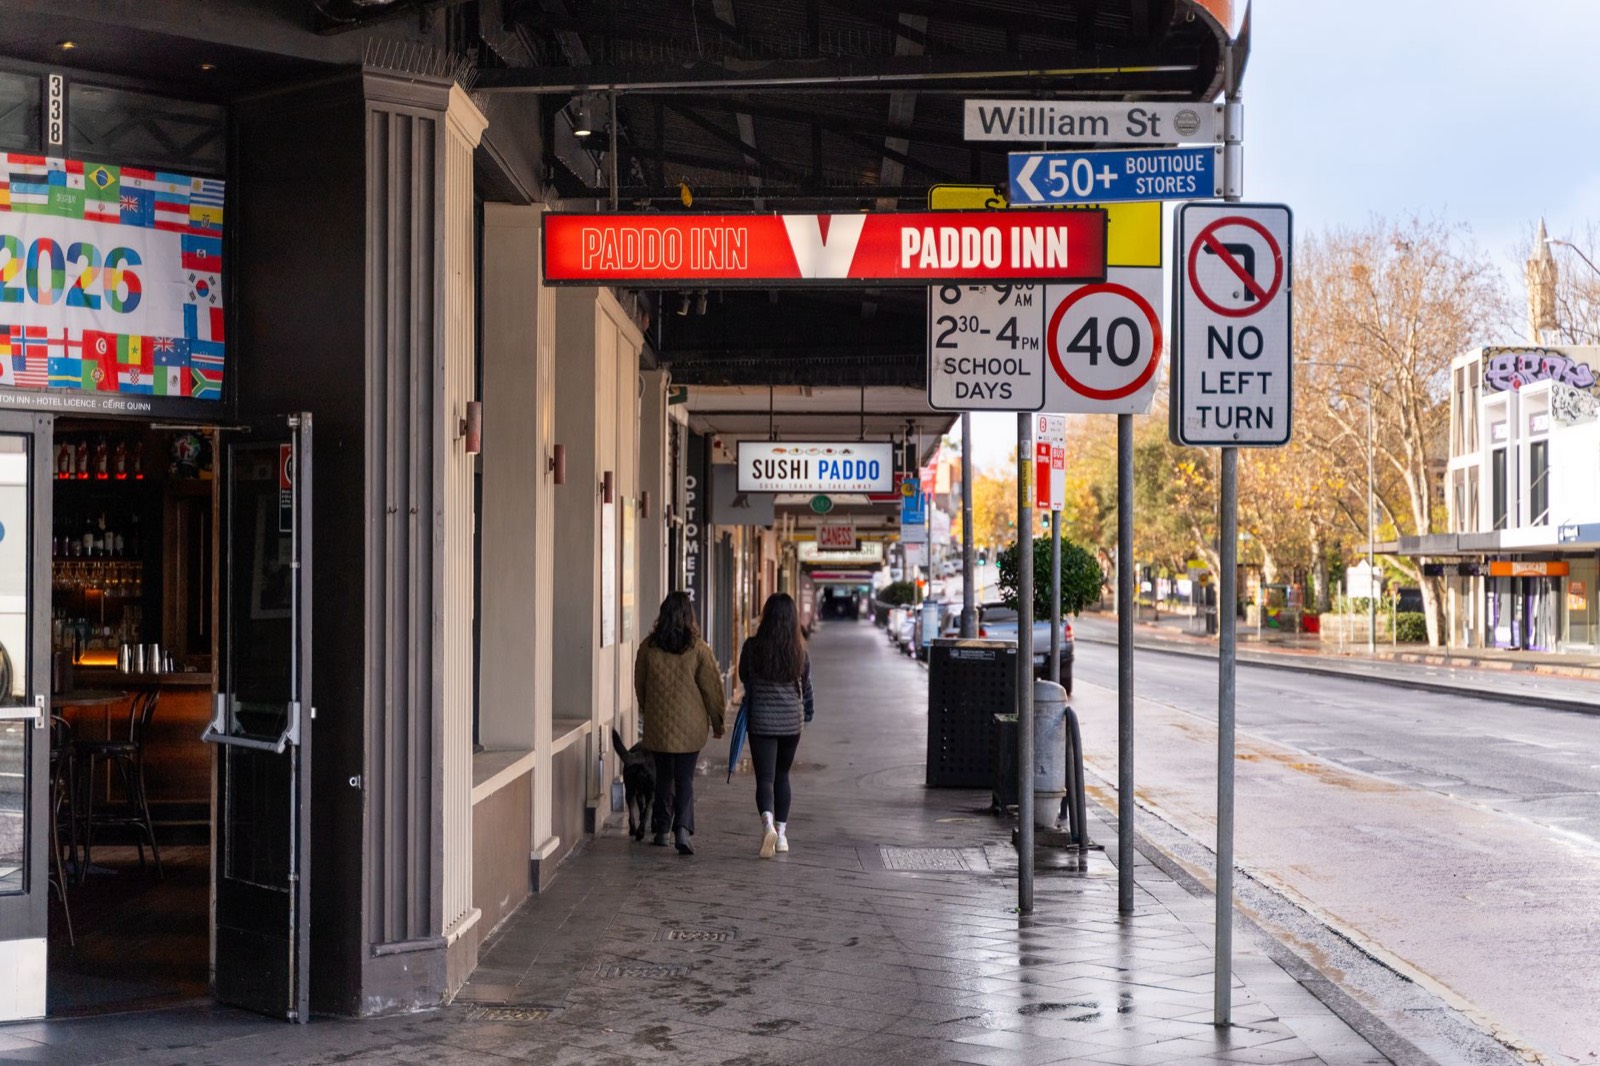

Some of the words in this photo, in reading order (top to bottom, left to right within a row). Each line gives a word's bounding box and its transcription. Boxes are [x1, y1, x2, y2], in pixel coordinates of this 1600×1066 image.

[51, 76, 61, 143] 338
[978, 106, 1109, 136] William
[1126, 108, 1161, 137] St
[1125, 154, 1205, 174] BOUTIQUE
[1049, 157, 1118, 197] 50+
[1136, 175, 1196, 194] STORES
[582, 227, 683, 270] PADDO
[690, 227, 748, 270] INN
[901, 226, 1002, 269] PADDO
[1010, 226, 1068, 268] INN
[0, 234, 142, 314] 2026
[1066, 316, 1141, 367] 40
[1207, 325, 1264, 360] NO
[943, 357, 1031, 376] SCHOOL
[955, 382, 1013, 400] DAYS
[1201, 371, 1272, 394] LEFT
[16, 396, 30, 405] INN
[37, 397, 62, 407] HOTEL
[63, 399, 97, 409] LICENCE
[127, 402, 151, 411] QUINN
[1196, 406, 1273, 429] TURN
[1053, 449, 1064, 458] BUS
[752, 459, 809, 480] SUSHI
[818, 459, 880, 481] PADDO
